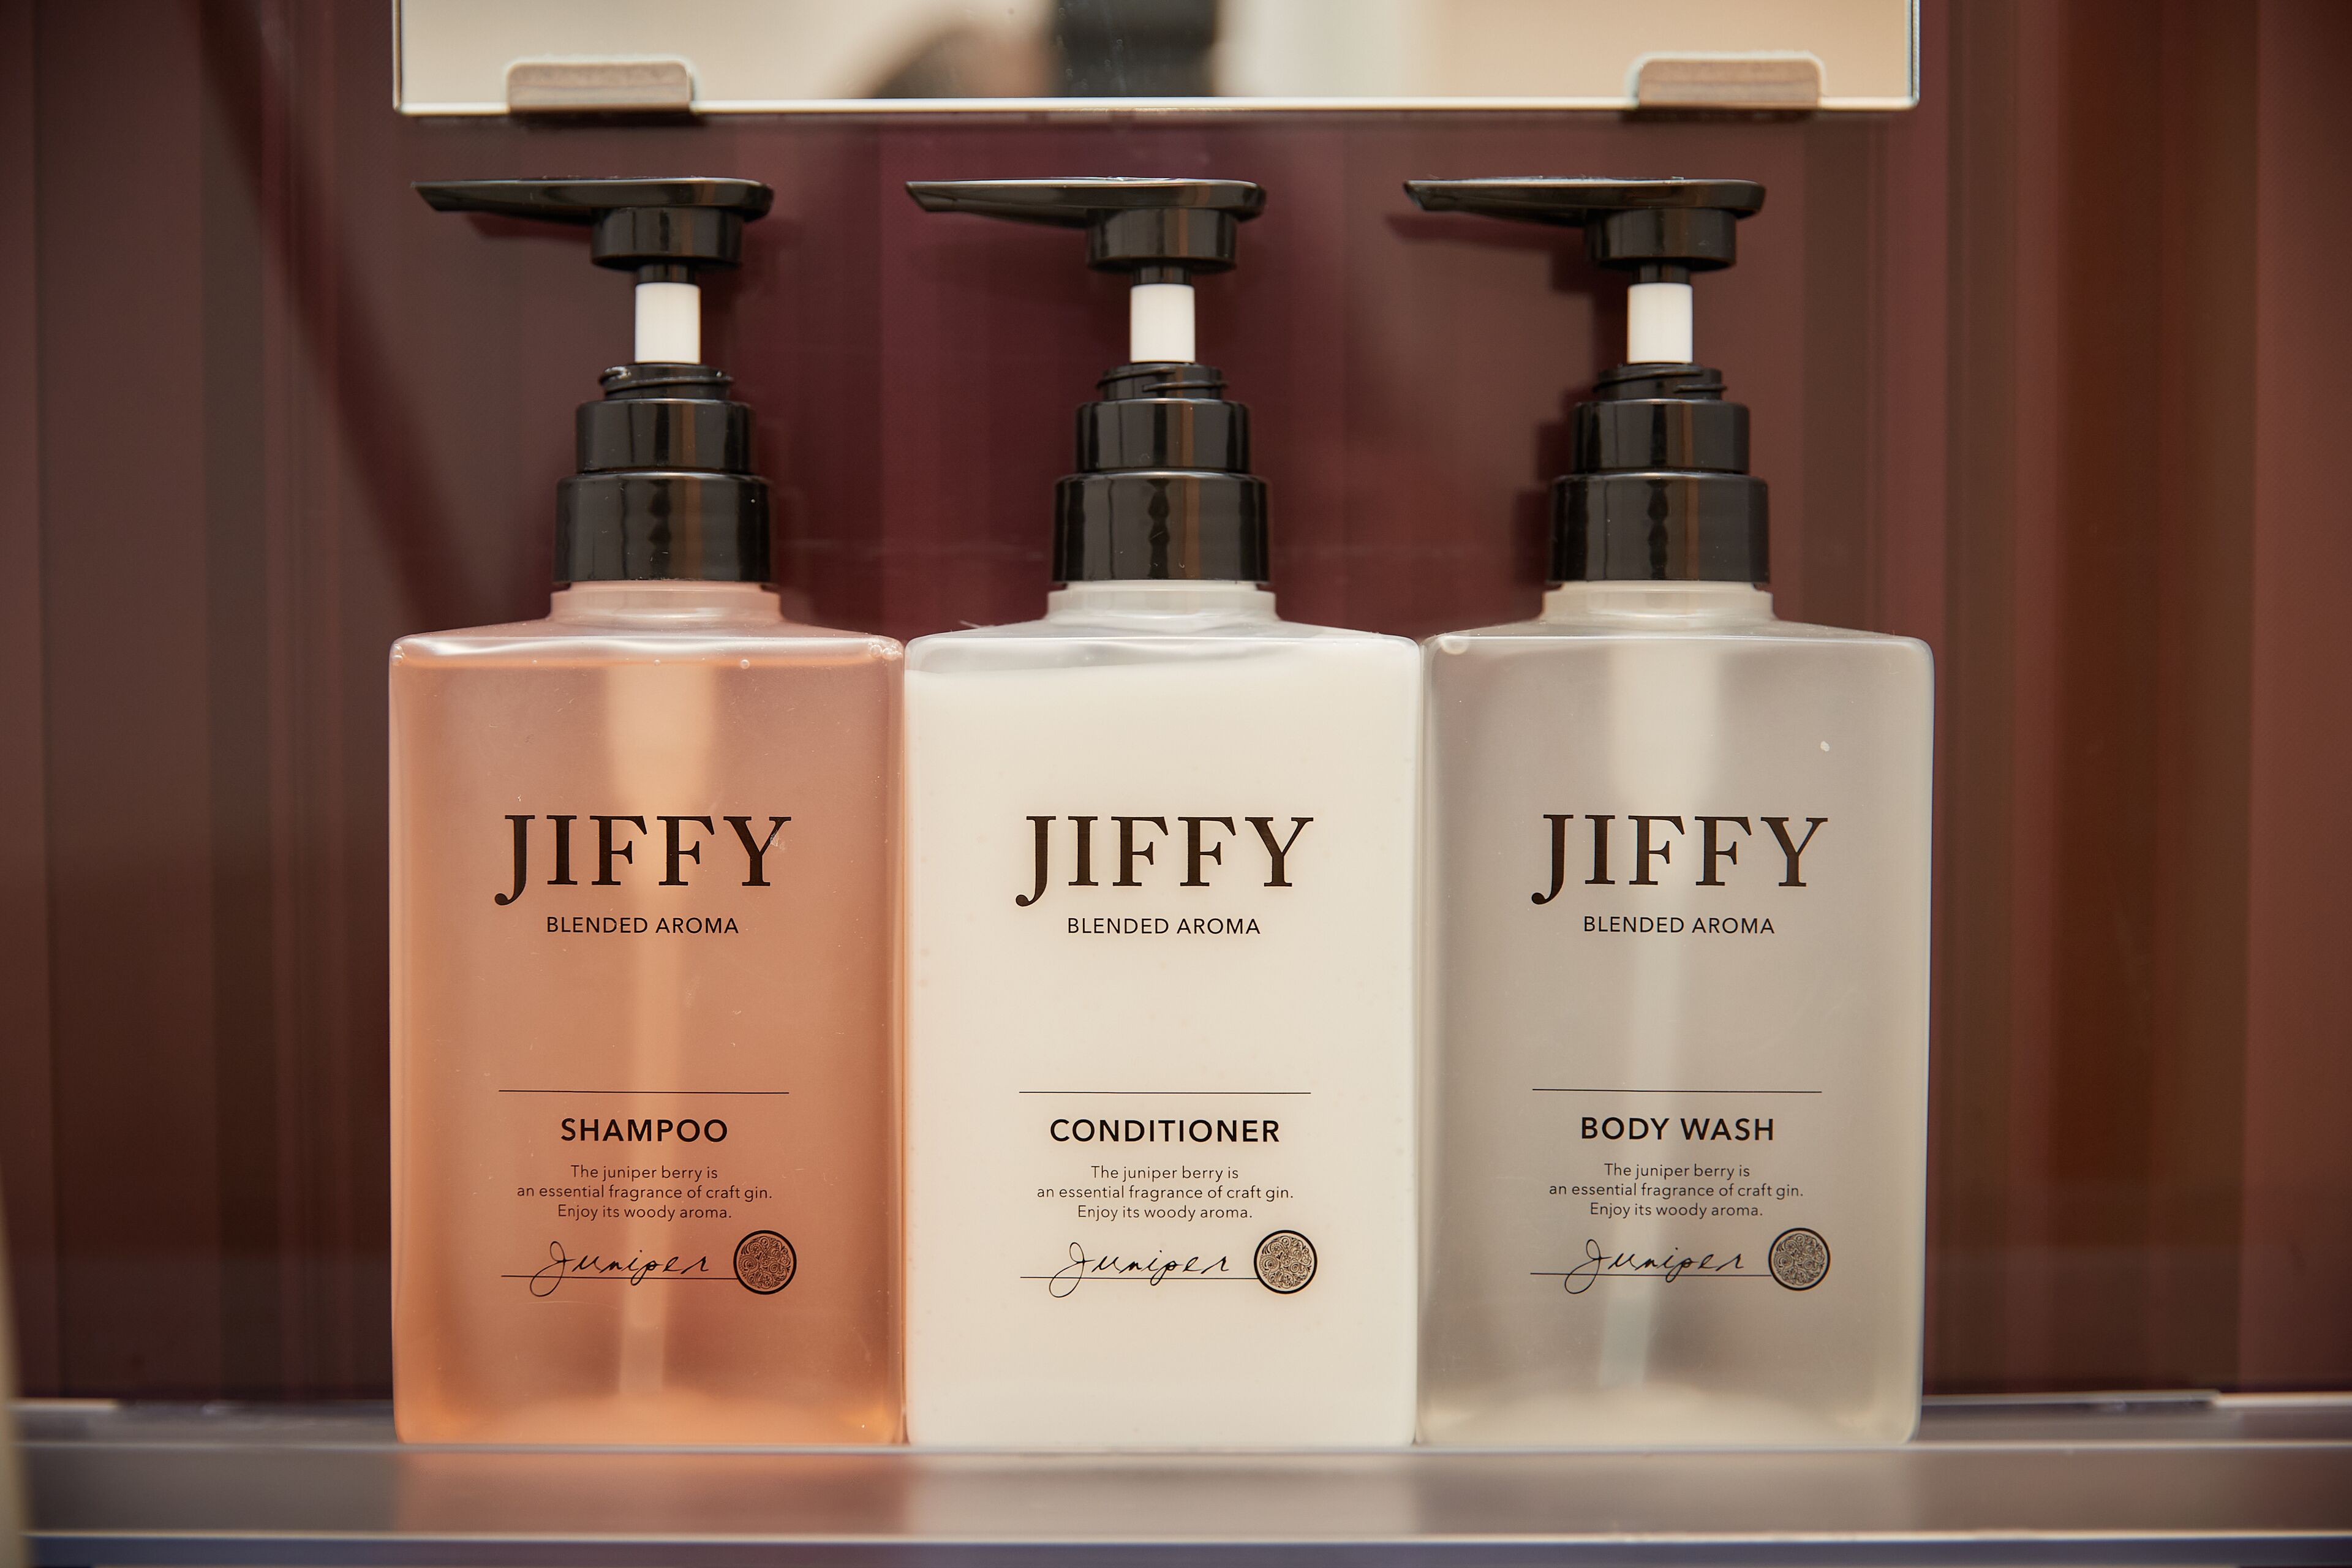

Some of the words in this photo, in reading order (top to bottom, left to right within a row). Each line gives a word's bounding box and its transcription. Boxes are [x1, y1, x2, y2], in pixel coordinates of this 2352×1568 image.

[494, 815, 792, 906] JIFFY
[1015, 815, 1314, 907] JIFFY
[1531, 814, 1829, 905] JIFFY
[546, 916, 648, 933] BLENDED
[655, 917, 739, 934] AROMA
[1068, 918, 1169, 934] BLENDED
[1176, 918, 1261, 935] AROMA
[1584, 916, 1684, 933] BLENDED
[1691, 917, 1775, 934] AROMA
[560, 1117, 728, 1143] SHAMPOO
[1050, 1118, 1280, 1143] CONDITIONER
[1581, 1117, 1670, 1140] BODY
[1679, 1117, 1774, 1142] WASH
[570, 1164, 598, 1178] The
[602, 1166, 657, 1182] juniper
[662, 1165, 703, 1183] berry
[706, 1166, 718, 1179] is
[1090, 1164, 1119, 1179] The
[1122, 1166, 1178, 1183] juniper
[1182, 1165, 1224, 1183] berry
[1227, 1166, 1239, 1179] is
[1604, 1163, 1632, 1177] The
[1634, 1164, 1691, 1180] juniper
[1694, 1163, 1735, 1181] berry
[1739, 1164, 1750, 1177] is
[517, 1187, 535, 1197] an
[539, 1184, 605, 1198] essential
[608, 1184, 682, 1202] fragrance
[687, 1185, 703, 1199] of
[706, 1185, 741, 1199] craft
[744, 1186, 772, 1203] gin.
[1037, 1188, 1054, 1198] an
[1058, 1185, 1124, 1199] essential
[1128, 1185, 1203, 1202] fragrance
[1207, 1185, 1224, 1199] of
[1226, 1185, 1262, 1199] craft
[1265, 1186, 1294, 1202] gin.
[1549, 1185, 1567, 1195] an
[1571, 1182, 1637, 1196] essential
[1641, 1182, 1714, 1200] fragrance
[1719, 1183, 1735, 1197] of
[1737, 1183, 1773, 1197] craft
[1776, 1184, 1803, 1200] gin.
[558, 1204, 598, 1221] Enjoy
[603, 1205, 620, 1218] its
[624, 1204, 676, 1222] woody
[679, 1208, 732, 1219] aroma.
[1078, 1205, 1118, 1222] Enjoy
[1122, 1205, 1140, 1218] its
[1144, 1204, 1196, 1223] woody
[1200, 1209, 1253, 1218] aroma.
[1590, 1202, 1630, 1219] Enjoy
[1635, 1203, 1652, 1216] its
[1656, 1202, 1708, 1220] woody
[1711, 1207, 1763, 1216] aroma.
[529, 1241, 710, 1297] Juniper
[1049, 1242, 1230, 1298] Juniper
[1564, 1239, 1745, 1294] Juniper
